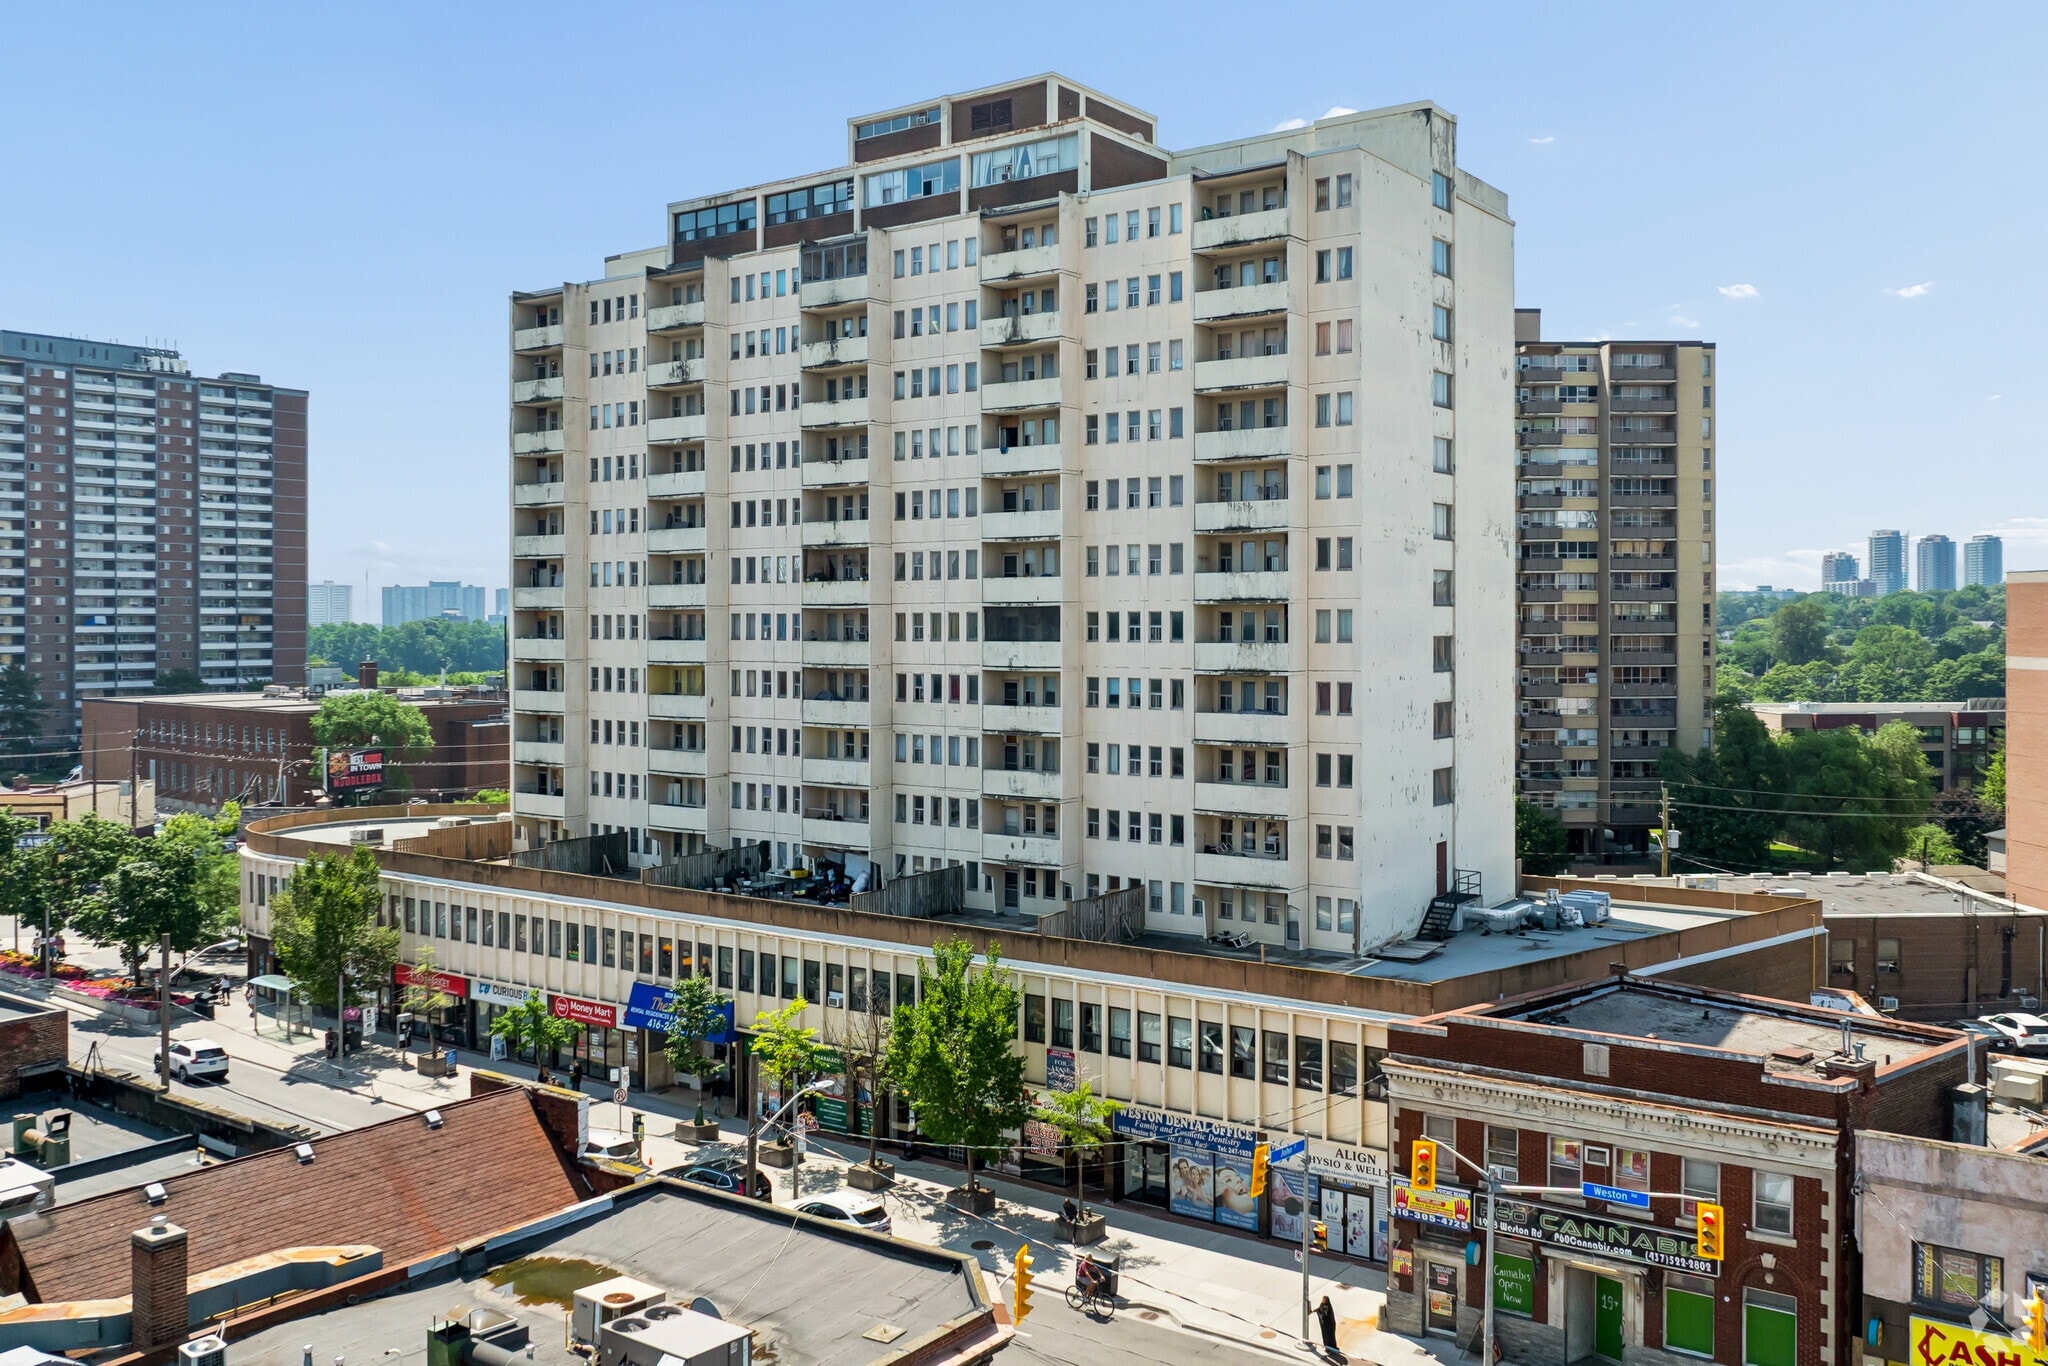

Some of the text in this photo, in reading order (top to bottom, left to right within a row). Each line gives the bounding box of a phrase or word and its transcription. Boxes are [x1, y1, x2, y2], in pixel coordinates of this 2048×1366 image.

[359, 763, 382, 771] TOWN
[333, 773, 382, 788] NOODLEBOX
[492, 985, 522, 1000] CURIOUS
[570, 1001, 593, 1016] Money
[595, 1005, 611, 1018] Mart
[630, 1007, 644, 1015] RENTAL
[645, 1010, 669, 1020] RESIDENCES
[1120, 1107, 1254, 1141] WESTON DENTAL OFFICE
[1040, 1129, 1062, 1142] STEAK
[1131, 1128, 1149, 1137] Weston
[1134, 1120, 1241, 1149] Family and Cosmetic Dentistry
[1031, 1137, 1041, 1145] ON
[1031, 1145, 1057, 1157] DAILY
[1335, 1148, 1377, 1165] ALIGN
[1308, 1155, 1341, 1169] HYSIO
[1344, 1162, 1352, 1172] &
[1593, 1186, 1628, 1201] Weston
[1500, 1221, 1529, 1236] Weston
[1531, 1227, 1542, 1238] Rd
[1645, 1250, 1712, 1273] (437)522-2802
[1493, 1264, 1531, 1282] Cannabis
[1498, 1278, 1523, 1292] Open
[1503, 1292, 1522, 1304] Now
[1601, 1294, 1619, 1310] 19+
[1918, 1325, 2021, 1366] CASH
